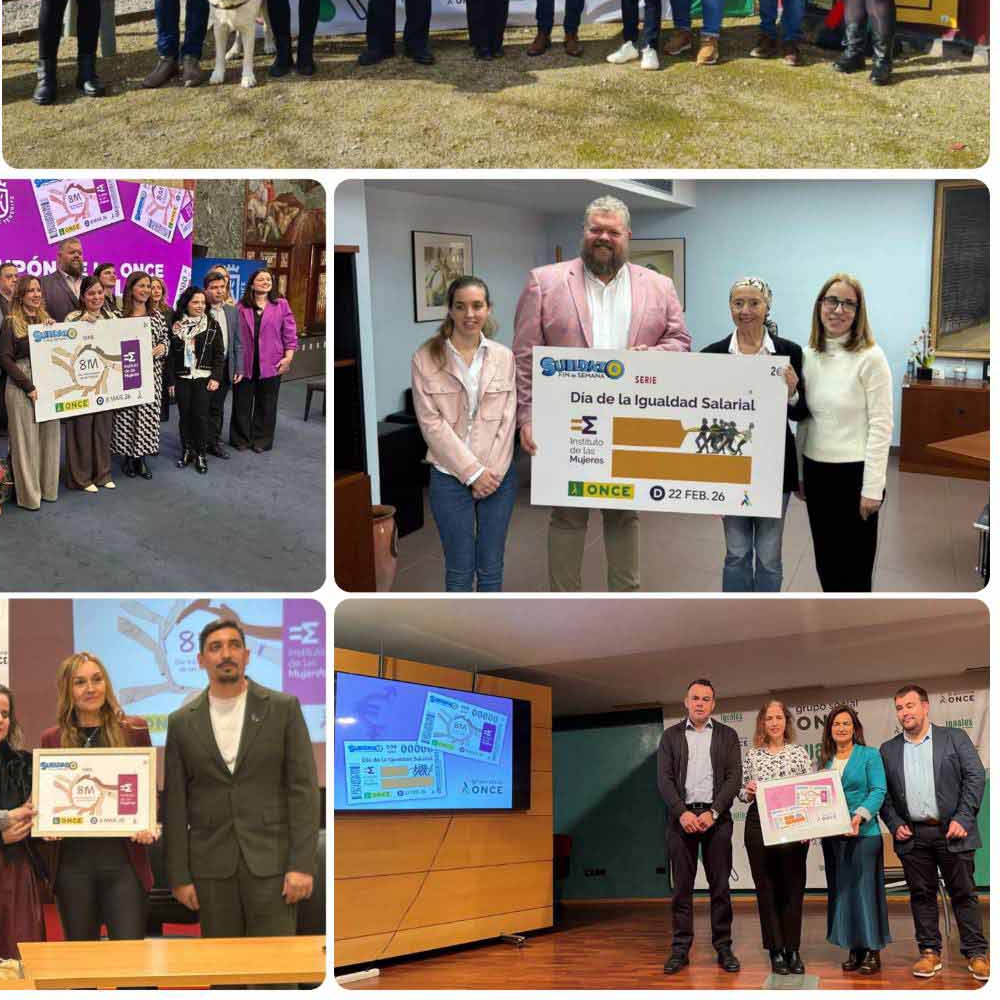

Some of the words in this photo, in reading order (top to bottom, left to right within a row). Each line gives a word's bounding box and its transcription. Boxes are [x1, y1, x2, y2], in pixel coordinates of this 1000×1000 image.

[79, 359, 100, 371] 8M
[634, 376, 657, 385] SERIE
[65, 399, 89, 410] ONCE
[570, 391, 593, 404] Día
[596, 392, 616, 405] de
[618, 393, 632, 406] la
[634, 394, 698, 410] Igualdad
[701, 397, 756, 412] Salarial
[569, 437, 605, 447] Instituto
[570, 447, 582, 455] de
[583, 447, 596, 455] las
[569, 455, 606, 465] Mujeres
[587, 484, 631, 497] ONCE
[668, 489, 682, 499] 22
[684, 490, 710, 501] FEB.
[712, 490, 726, 502] 26
[947, 694, 976, 703] ONCE
[795, 703, 827, 715] grupo
[471, 786, 503, 795] ONCE
